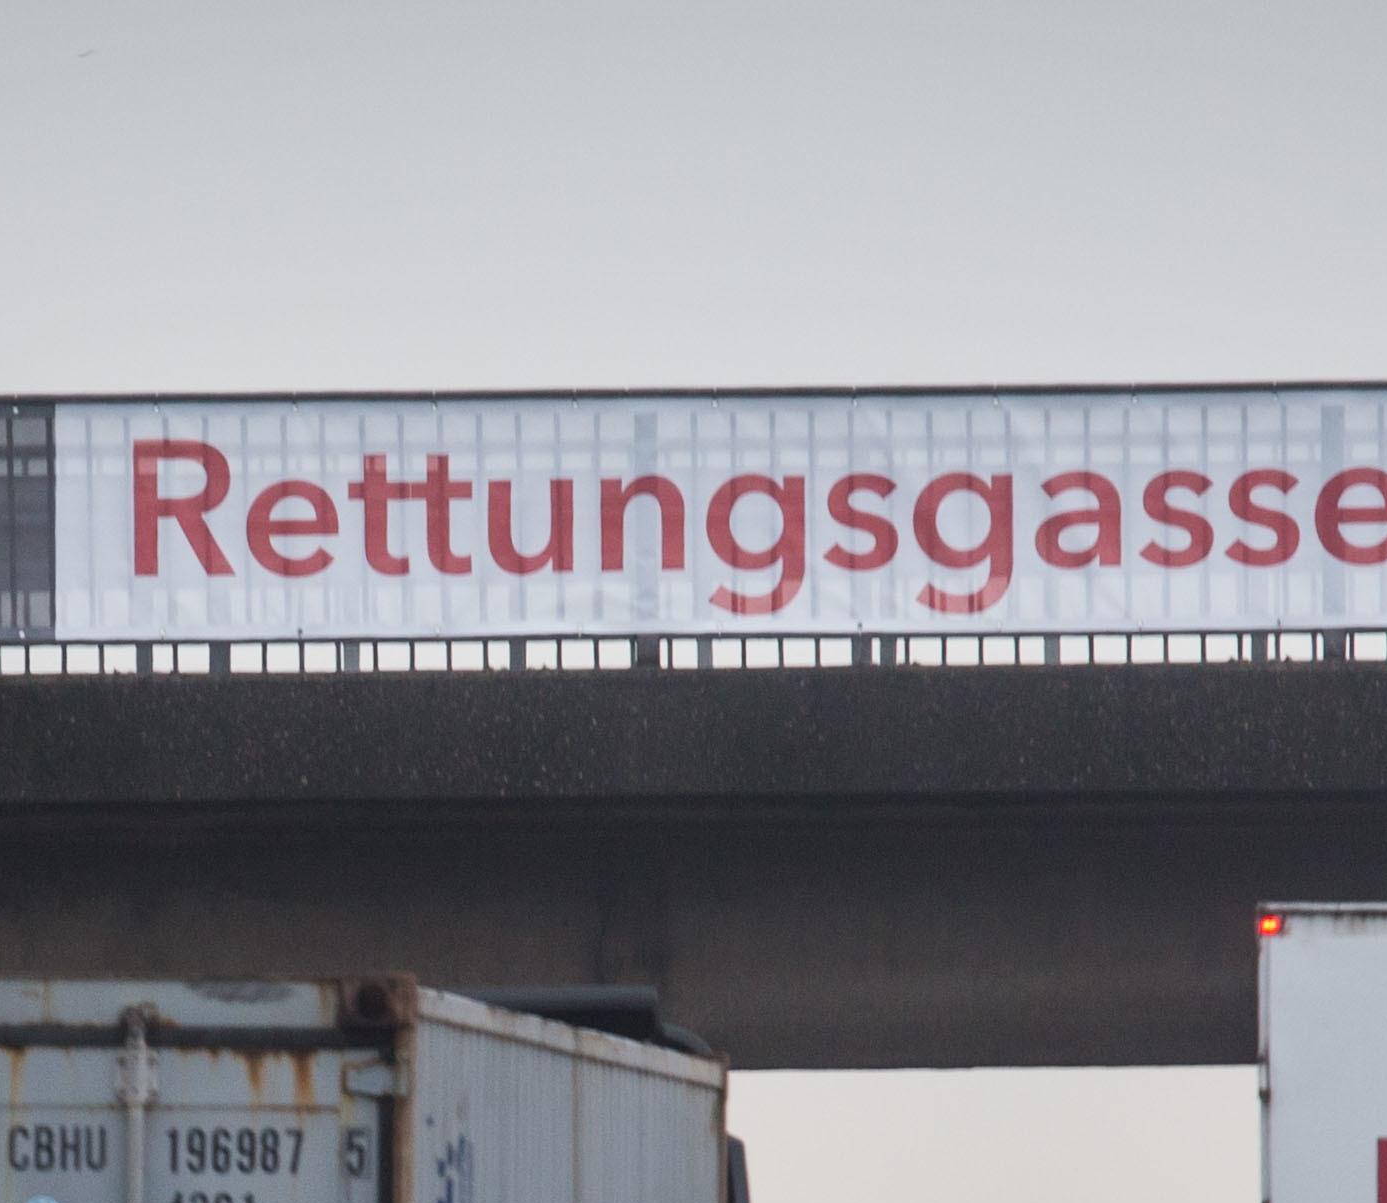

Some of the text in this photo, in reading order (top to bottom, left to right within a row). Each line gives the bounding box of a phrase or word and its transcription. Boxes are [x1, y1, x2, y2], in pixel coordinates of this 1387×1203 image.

[8, 1124, 365, 1179] CBHU 196987 5
